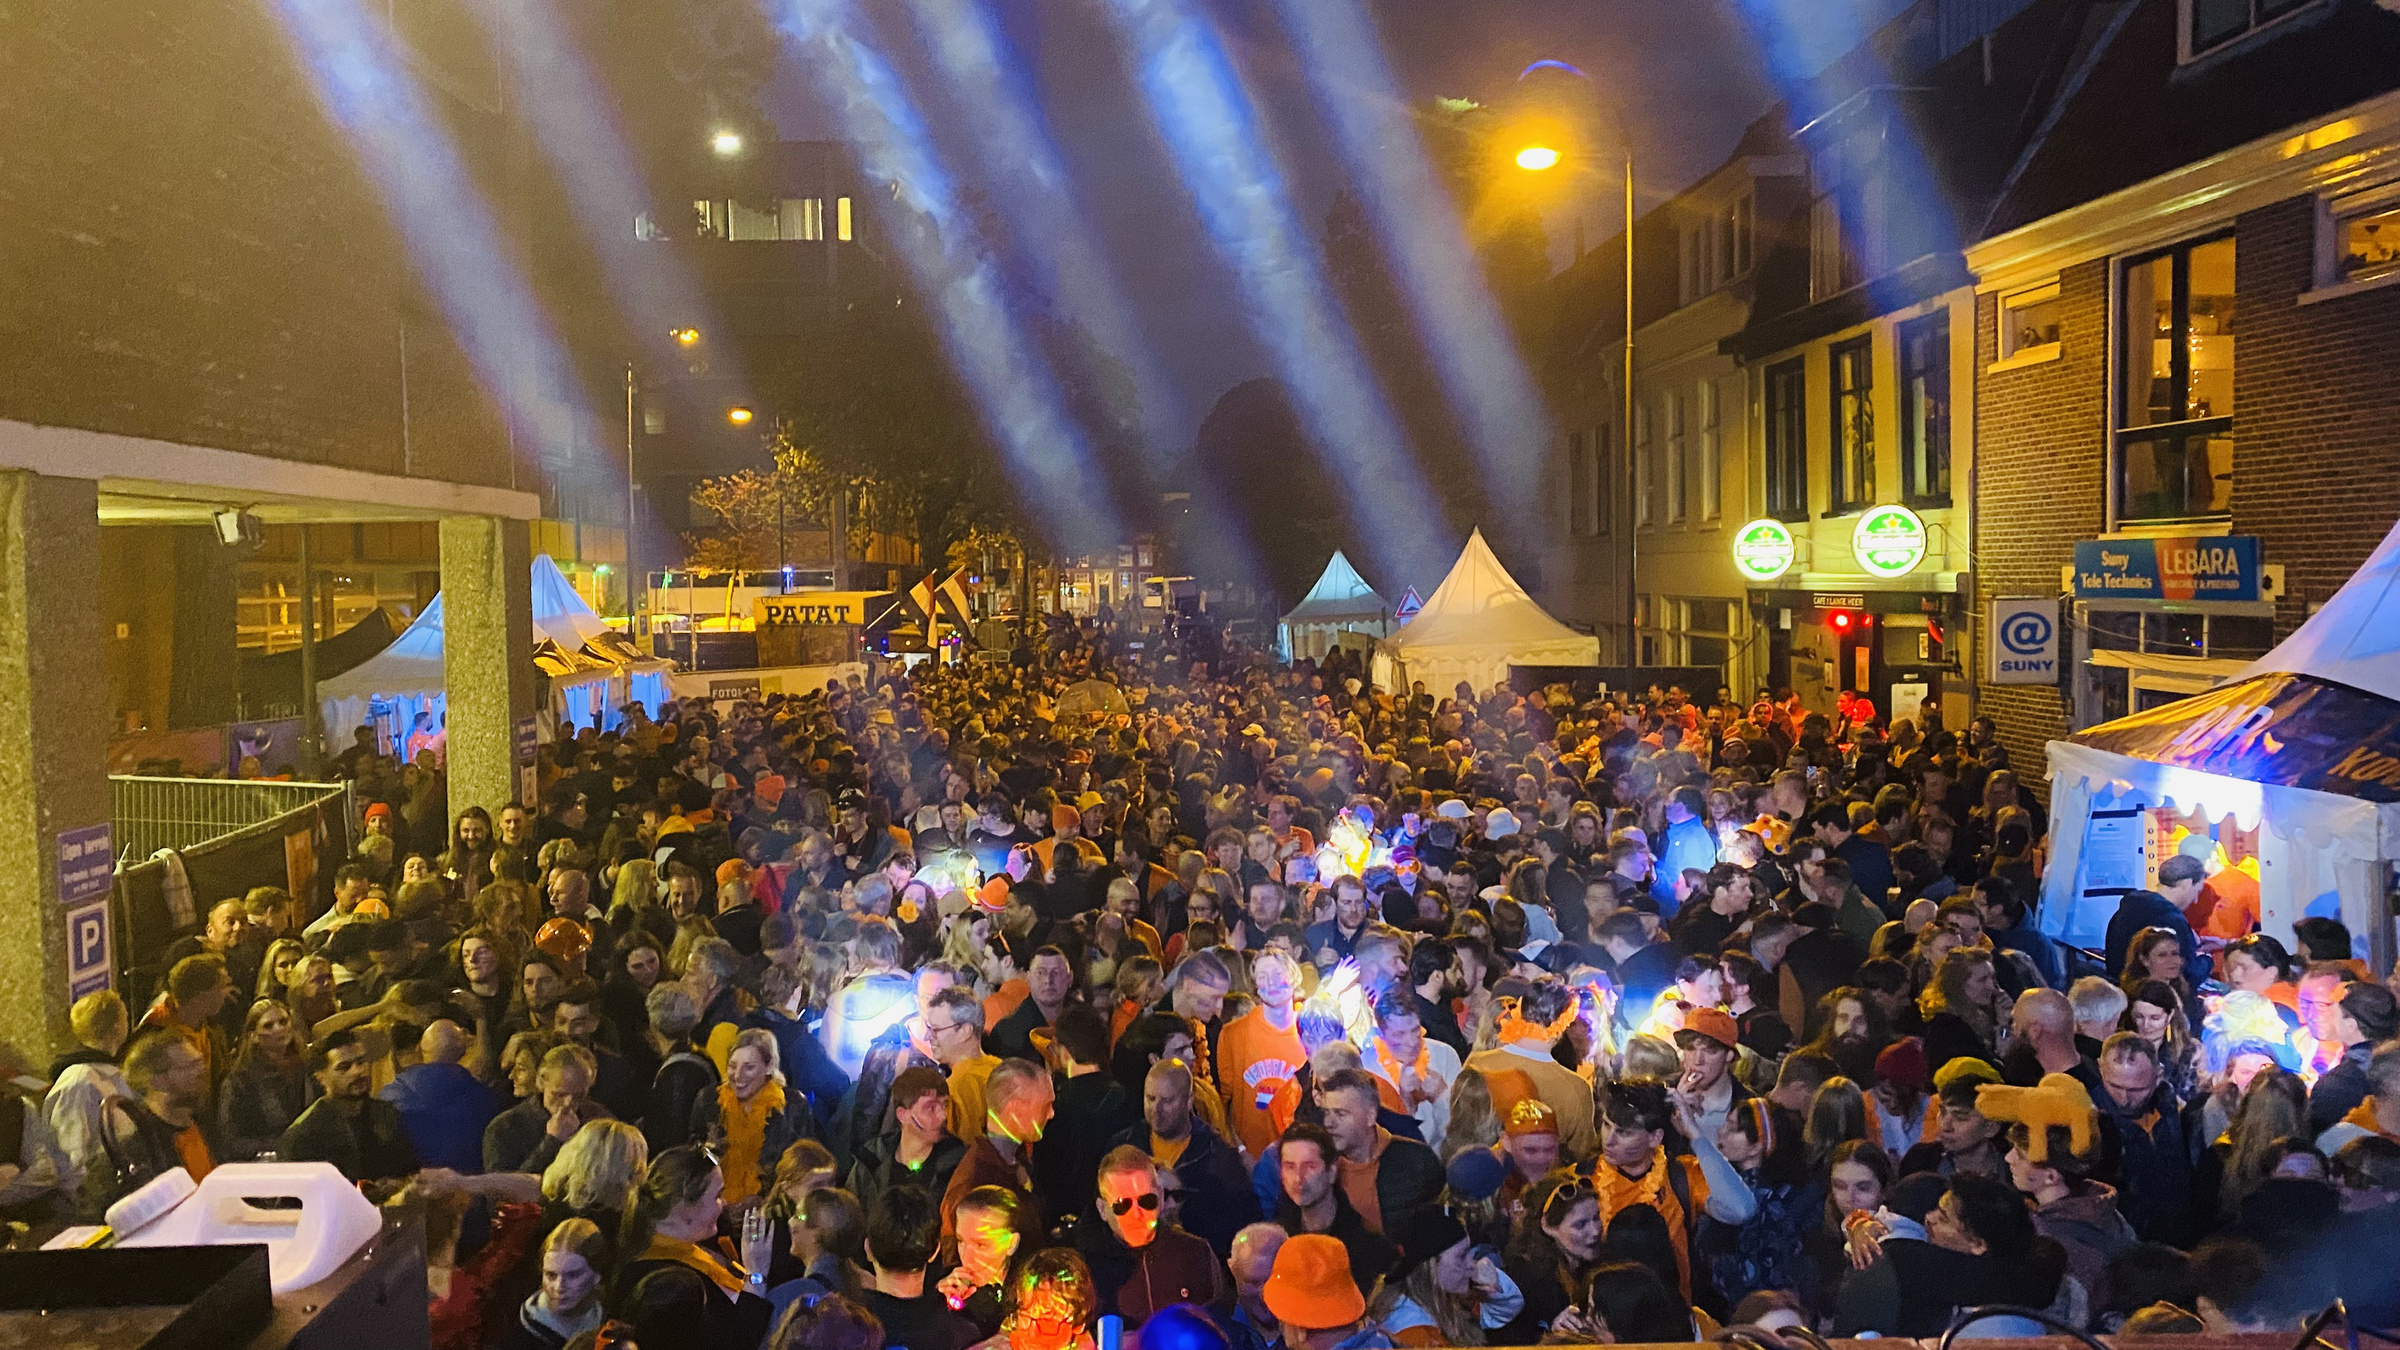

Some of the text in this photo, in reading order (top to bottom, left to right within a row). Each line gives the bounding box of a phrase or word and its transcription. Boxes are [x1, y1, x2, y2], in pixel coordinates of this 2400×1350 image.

[2163, 547, 2240, 575] LEBARA
[2081, 572, 2102, 588] Tele
[2103, 572, 2153, 589] Technics
[766, 605, 850, 625] PATAT
[2000, 660, 2054, 671] SUNY
[2172, 704, 2274, 755] BAR
[80, 919, 100, 964] P
